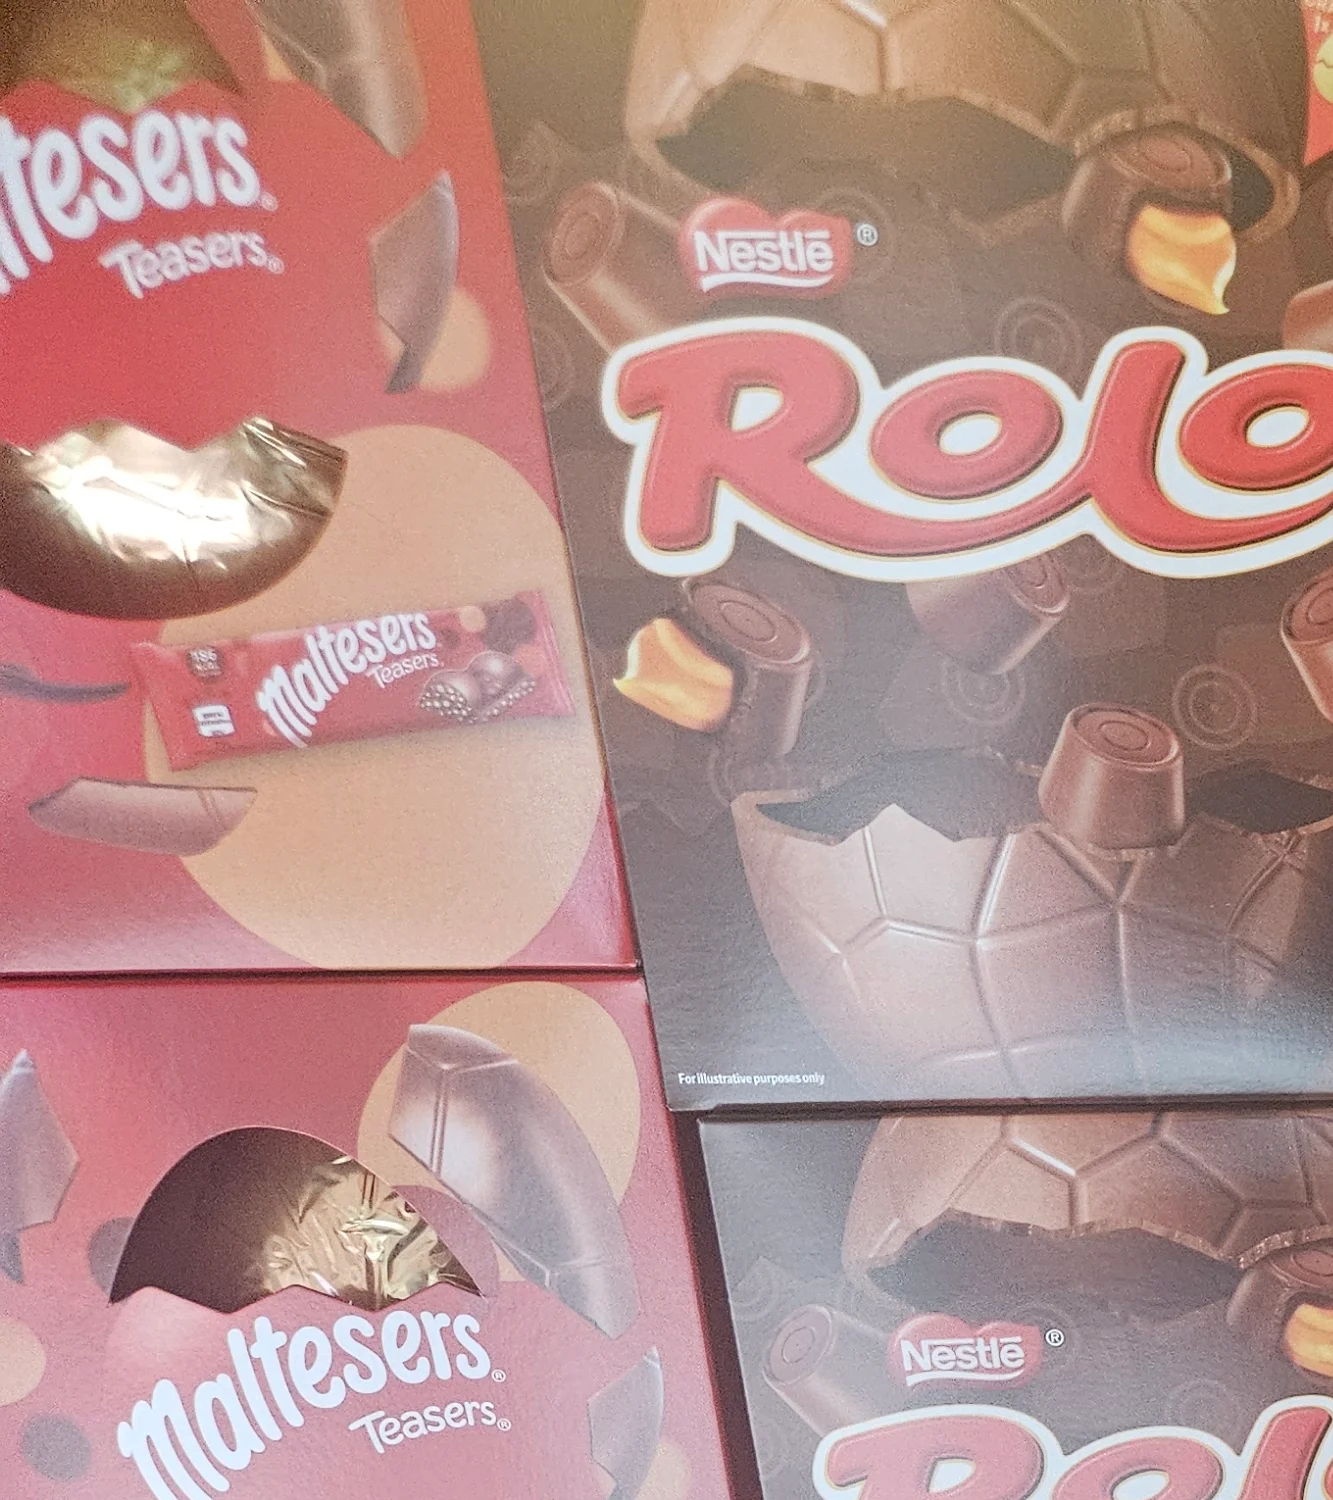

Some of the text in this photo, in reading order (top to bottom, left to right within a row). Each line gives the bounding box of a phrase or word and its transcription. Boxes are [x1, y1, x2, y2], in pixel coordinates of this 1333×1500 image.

[0, 108, 263, 302] tesers
[101, 229, 266, 298] Teasers
[256, 612, 437, 748] Maltesers
[365, 651, 441, 689] Teasers
[678, 1072, 825, 1086] For illustrative purposes only
[349, 1399, 497, 1453] Teasers
